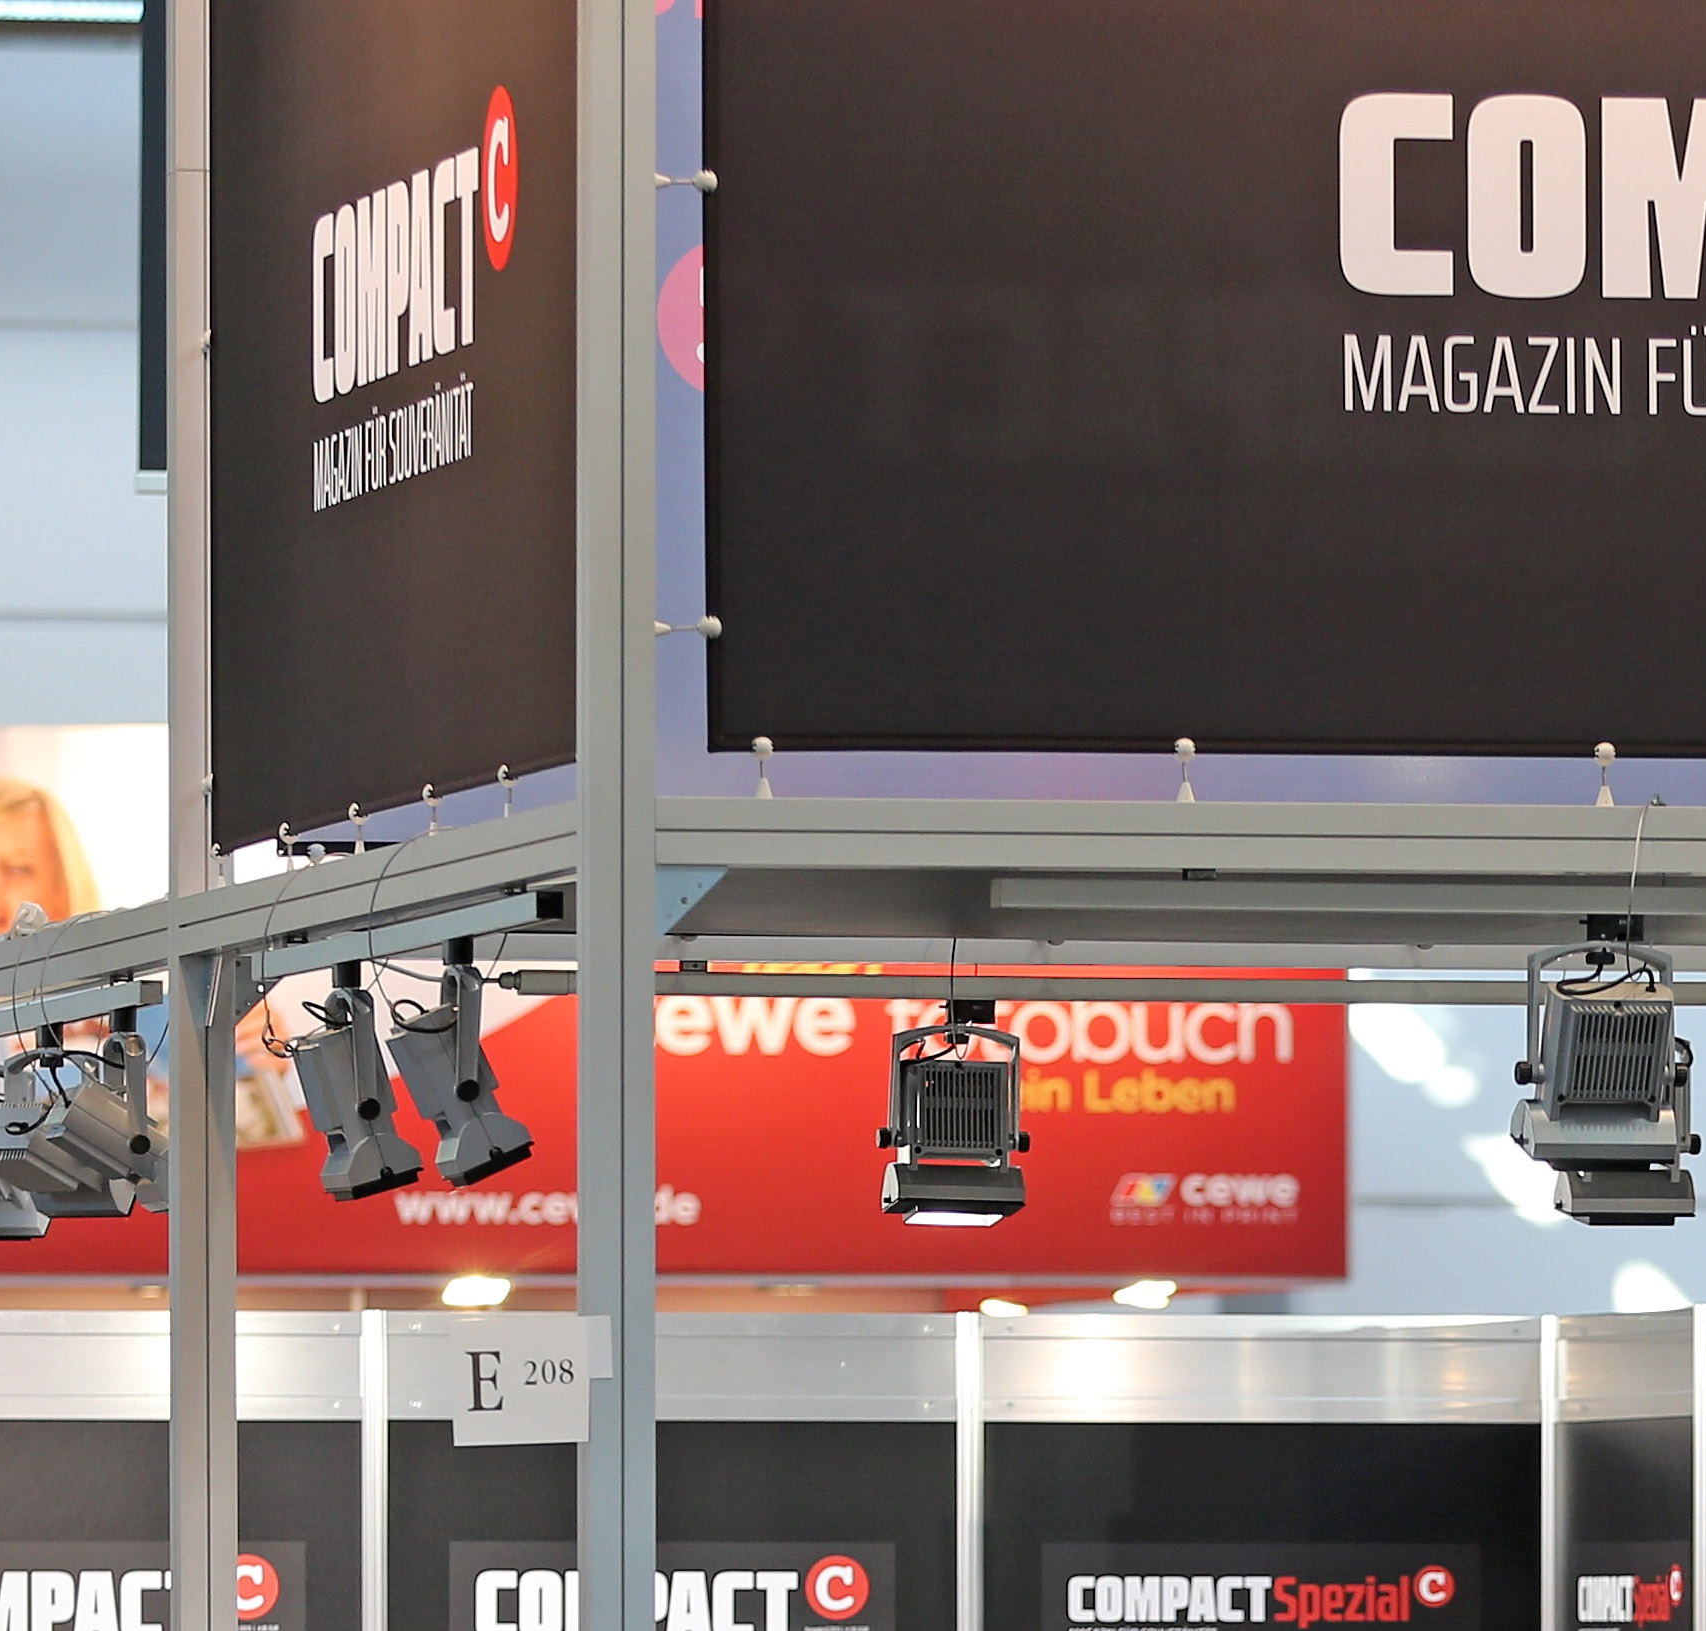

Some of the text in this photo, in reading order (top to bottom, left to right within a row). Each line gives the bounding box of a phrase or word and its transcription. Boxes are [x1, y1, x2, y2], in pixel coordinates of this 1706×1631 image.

[313, 146, 479, 403] COMPACT
[1344, 333, 1621, 415] MAGAZIN
[313, 371, 474, 512] MAGAZIN FÜR SOUVERÄNITÄT
[654, 997, 856, 1057] ewe
[1082, 1068, 1237, 1114] Leben
[465, 1350, 575, 1412] E 208
